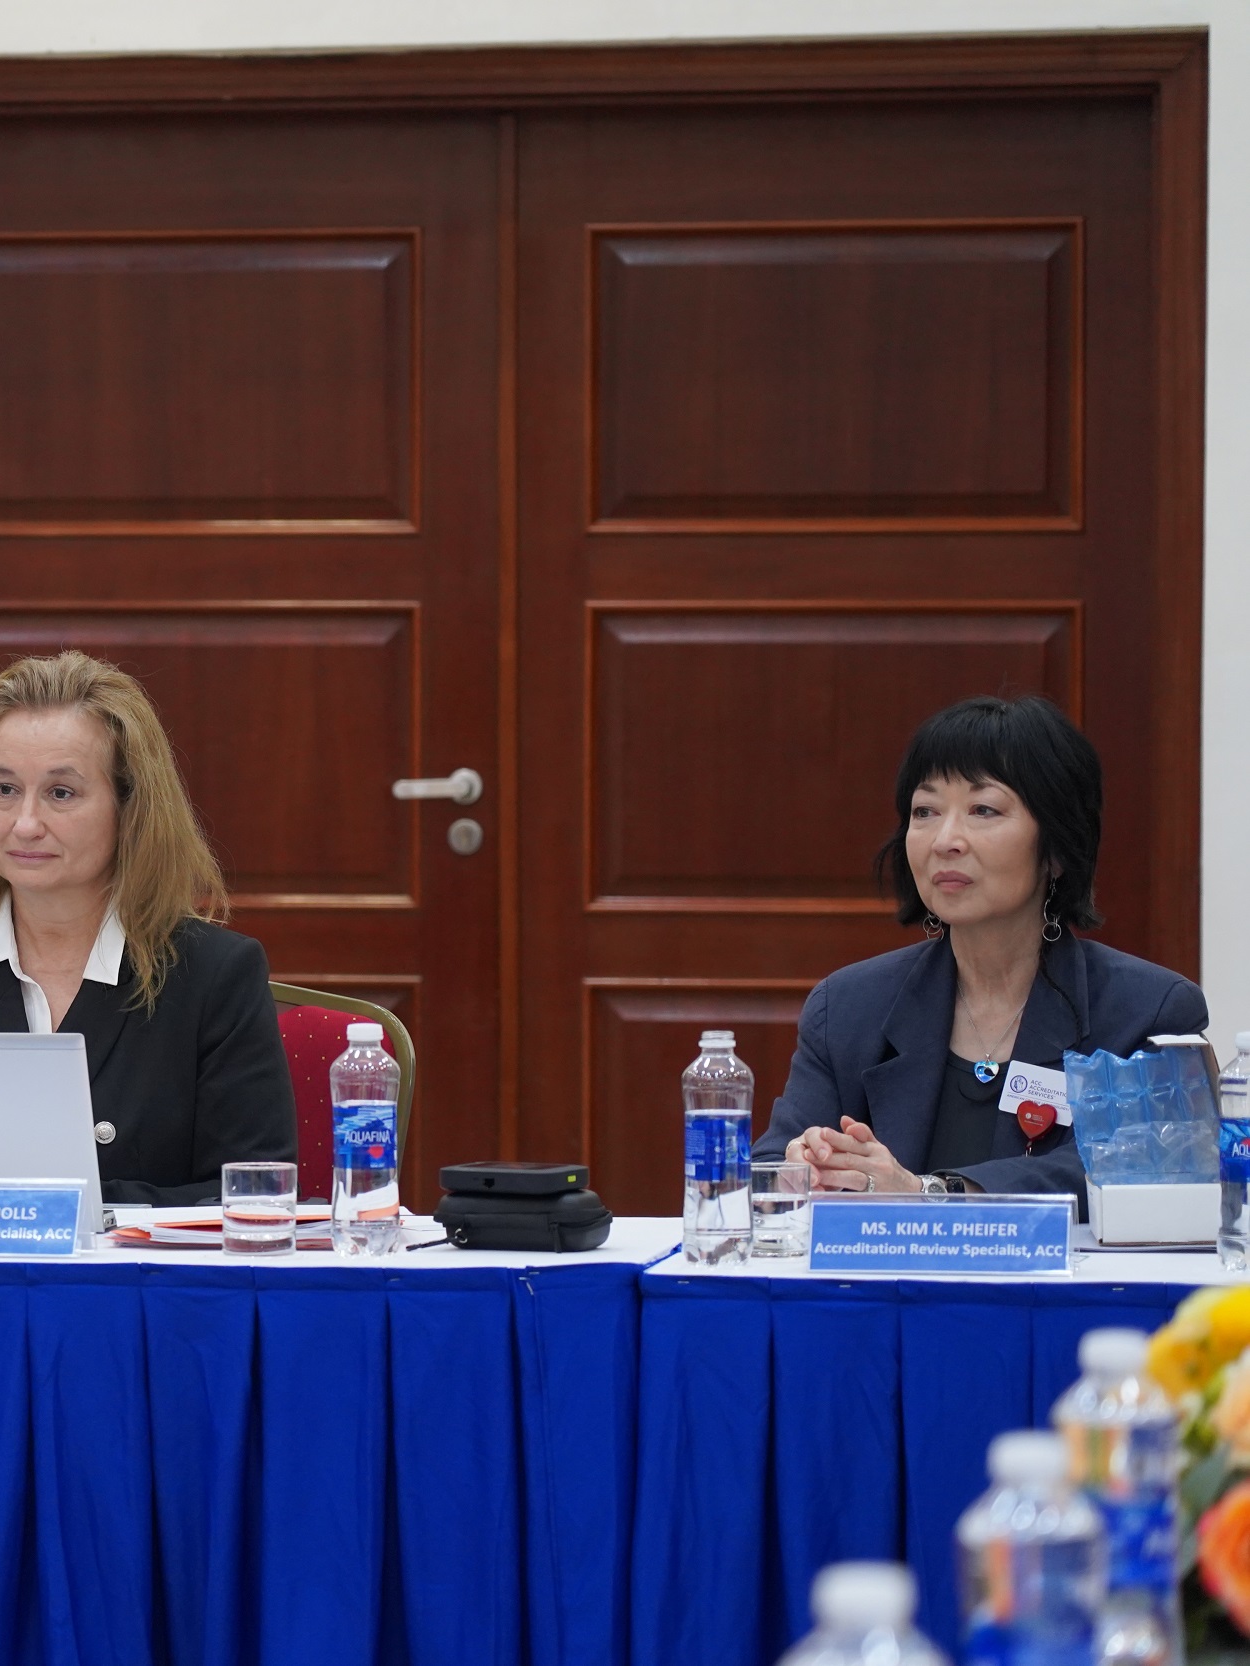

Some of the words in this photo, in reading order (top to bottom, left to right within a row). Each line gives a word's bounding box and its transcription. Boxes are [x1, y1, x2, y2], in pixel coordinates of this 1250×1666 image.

[1028, 1090, 1054, 1099] SERVICES
[343, 1129, 391, 1146] AQUAFINA
[45, 1228, 72, 1240] ACC
[861, 1221, 891, 1236] MS.
[896, 1222, 928, 1236] KIM
[932, 1222, 947, 1236] K.
[952, 1222, 1018, 1237] PHEIFER
[814, 1242, 906, 1255] Accreditation
[909, 1243, 959, 1256] Review
[962, 1244, 1031, 1259] Specialist,
[1035, 1245, 1063, 1257] ACC
